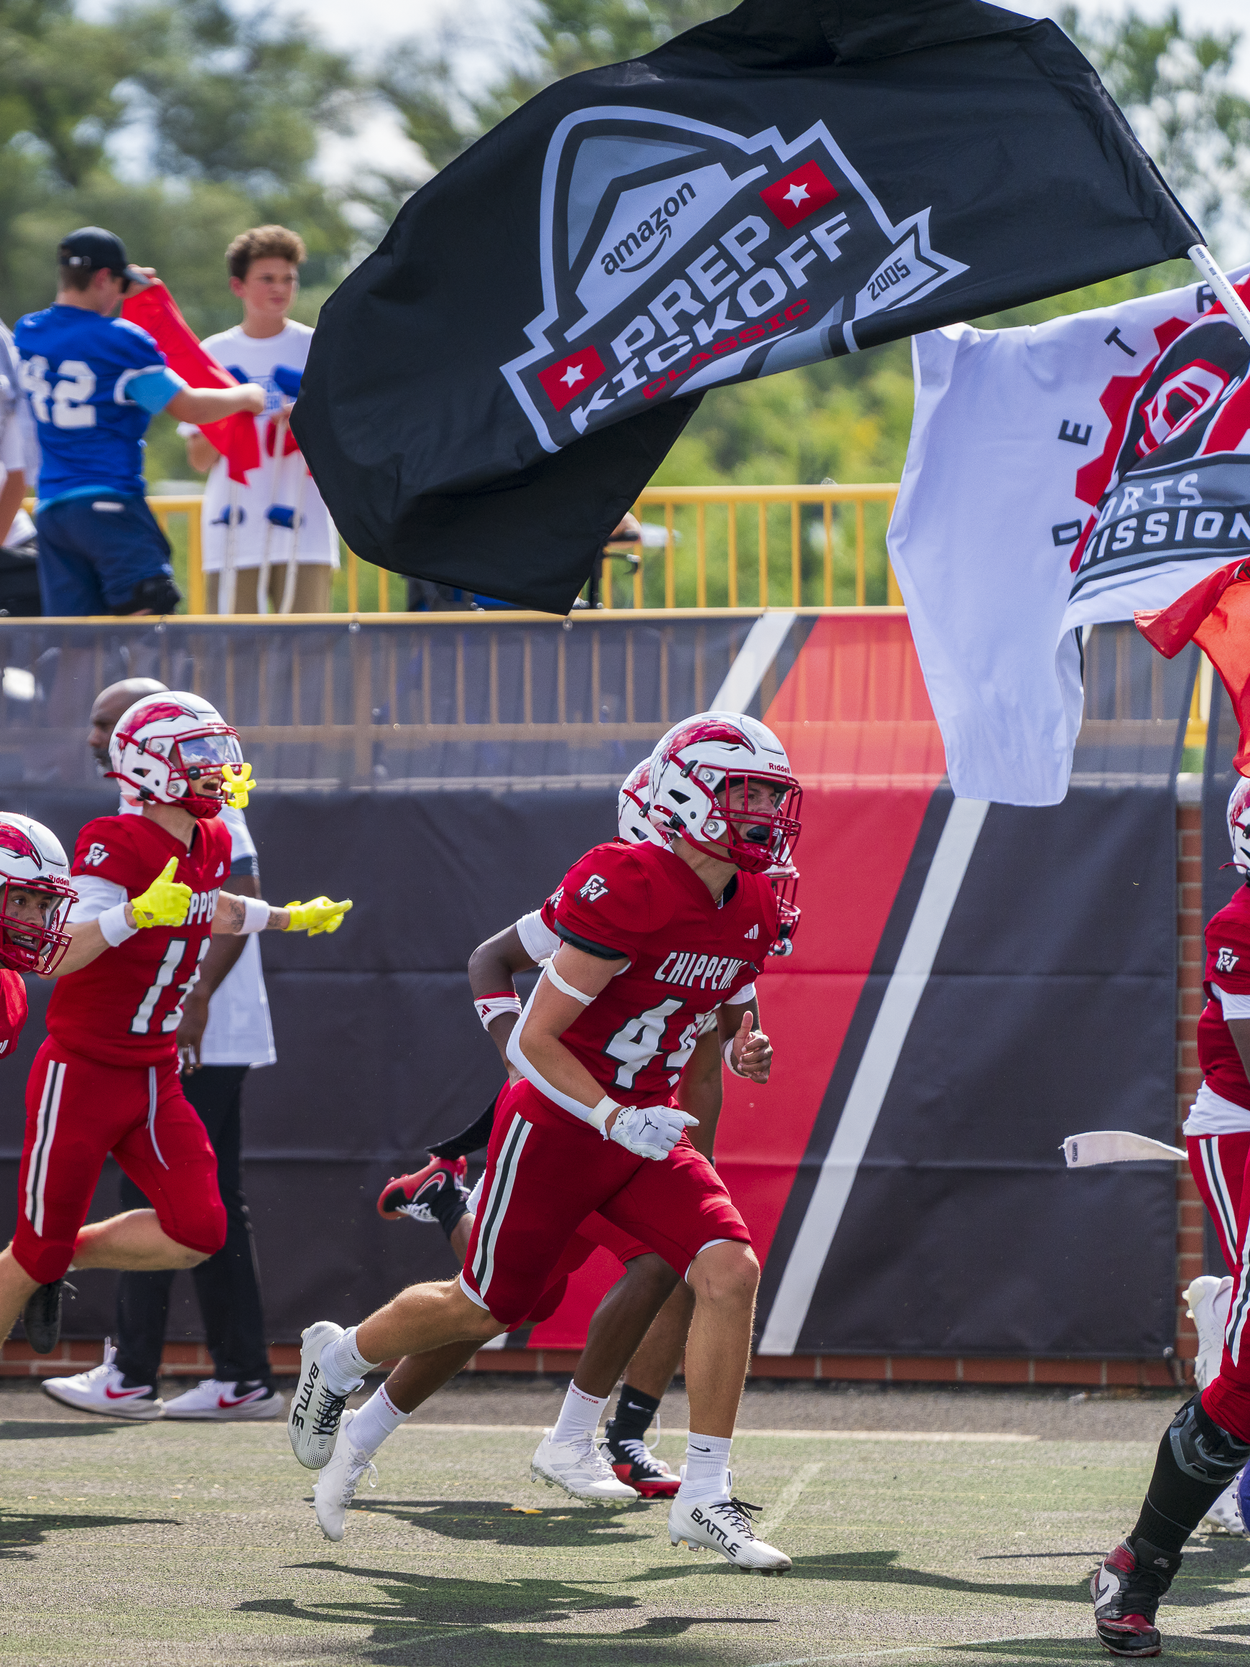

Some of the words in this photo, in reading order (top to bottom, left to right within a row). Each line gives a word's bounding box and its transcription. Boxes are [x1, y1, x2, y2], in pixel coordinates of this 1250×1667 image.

[600, 181, 697, 276] amazon
[610, 215, 770, 364] PREP
[867, 256, 912, 301] 2005
[570, 211, 851, 434] KICKOFF
[642, 298, 810, 399] CLASSIC
[1096, 472, 1203, 532] ORTS
[291, 1360, 320, 1431] BATTLE
[690, 1507, 743, 1558] BATTLE
